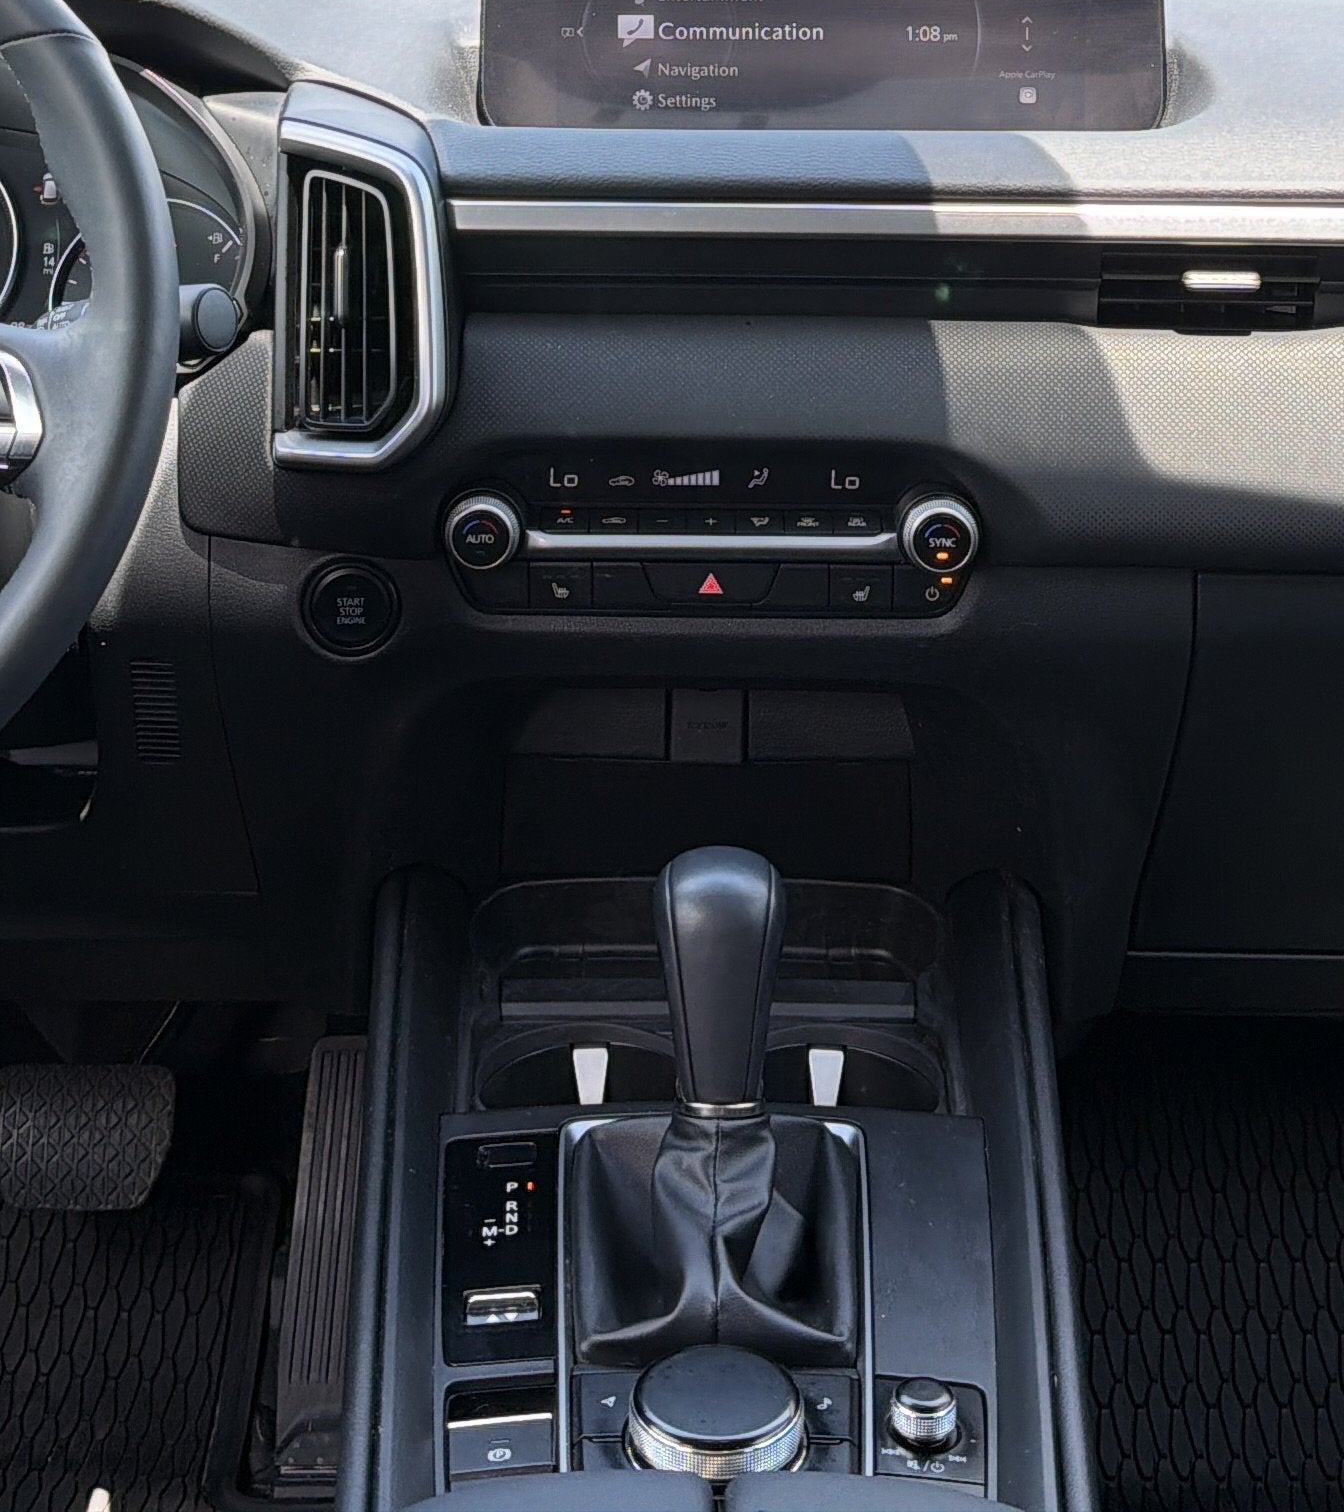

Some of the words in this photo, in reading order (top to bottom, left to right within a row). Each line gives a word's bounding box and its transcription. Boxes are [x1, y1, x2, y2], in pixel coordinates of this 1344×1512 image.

[658, 22, 824, 41] Communication
[906, 25, 941, 42] 1:08
[943, 32, 958, 43] pm
[658, 62, 739, 81] Navigation
[999, 70, 1023, 80] Apple
[1024, 70, 1056, 81] CarPlay
[657, 93, 717, 112] Settings
[43, 256, 55, 267] 14
[213, 253, 221, 264] F
[549, 467, 578, 487] Lo
[830, 468, 860, 489] Lo
[465, 534, 494, 544] AUTO
[928, 537, 956, 548] SYNC
[336, 597, 366, 607] START
[339, 607, 364, 616] STOP
[336, 616, 367, 625] ENGINE
[506, 1181, 518, 1193] P
[505, 1200, 518, 1212] R
[505, 1212, 518, 1224] N
